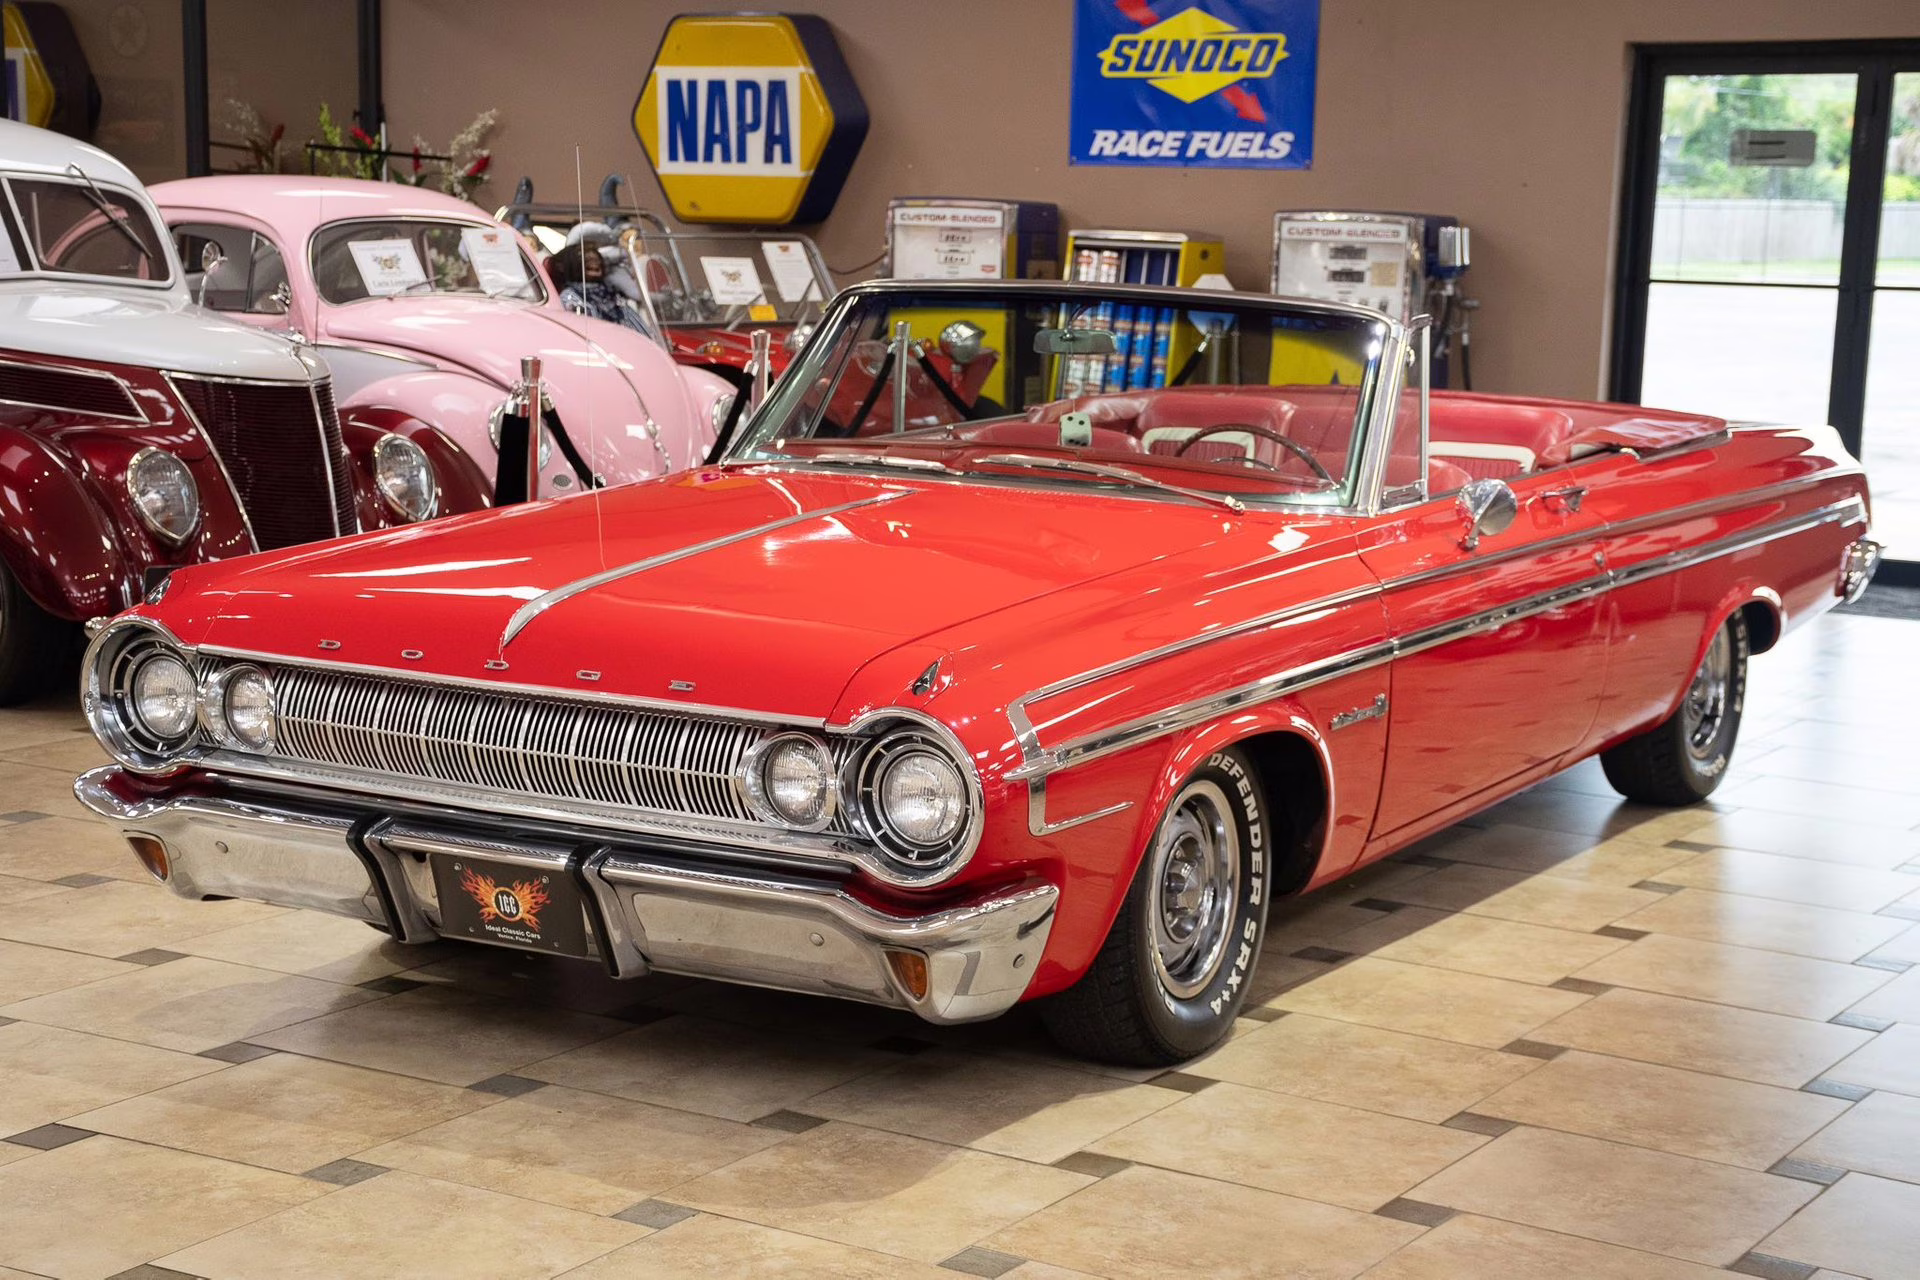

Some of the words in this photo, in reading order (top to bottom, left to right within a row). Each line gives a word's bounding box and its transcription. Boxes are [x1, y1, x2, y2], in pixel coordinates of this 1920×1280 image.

[1108, 39, 1279, 72] SUNOCO
[667, 80, 792, 164] NAPA
[1088, 130, 1186, 158] RACE
[1185, 131, 1296, 159] FUELS
[1208, 753, 1263, 906] DEFENDER
[498, 893, 517, 914] ICC
[485, 924, 501, 932] Ideal
[502, 927, 525, 936] Classic
[525, 931, 541, 940] Cars
[1210, 918, 1257, 1016] SRX+4
